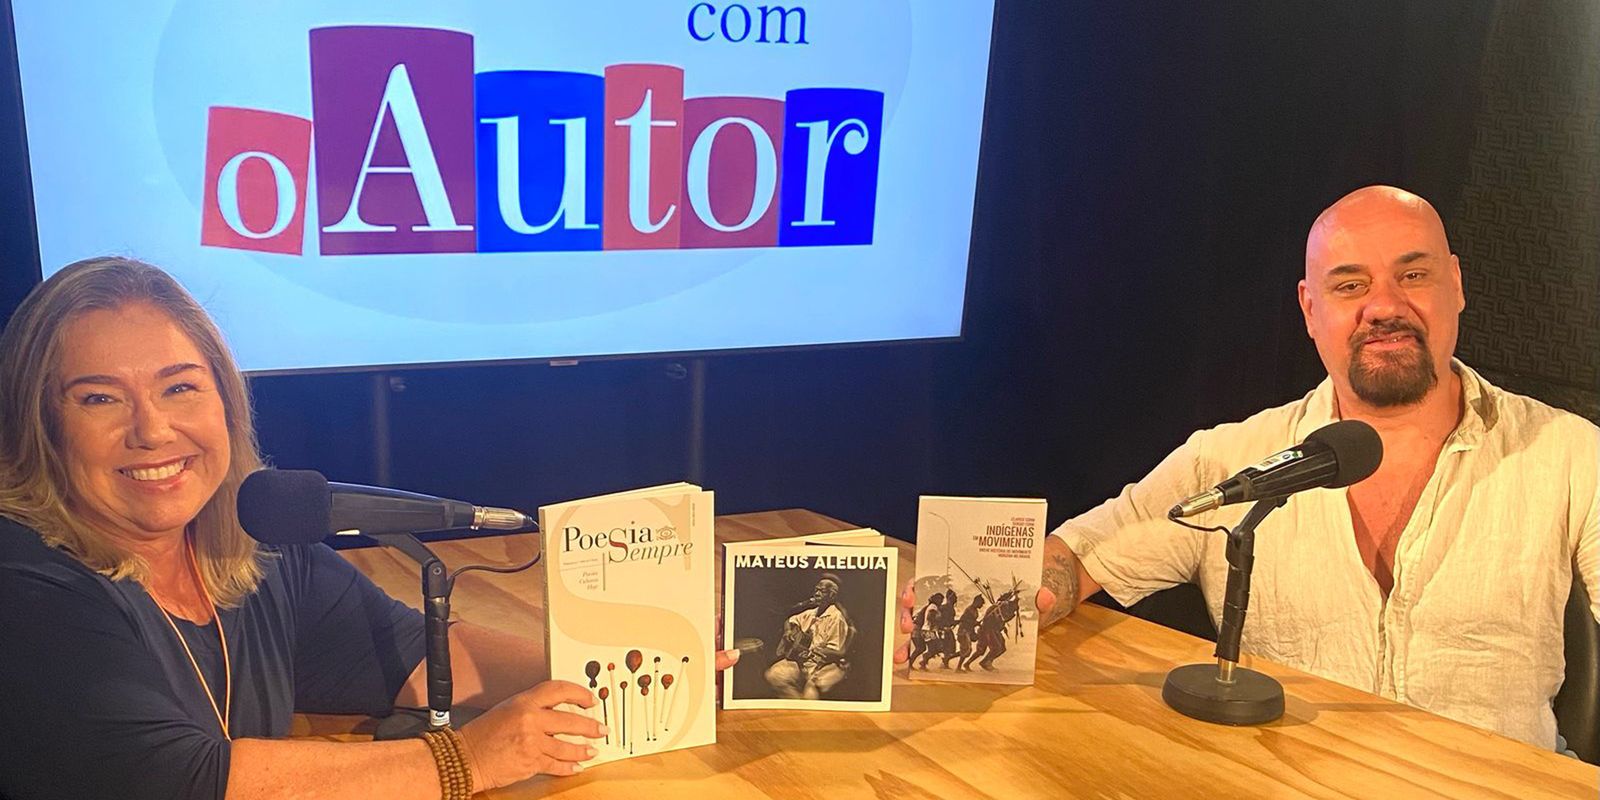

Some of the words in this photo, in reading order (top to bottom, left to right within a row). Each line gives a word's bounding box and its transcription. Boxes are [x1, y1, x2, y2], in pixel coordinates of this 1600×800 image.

[687, 2, 810, 45] com
[986, 523, 1035, 537] INDÍGENAS
[978, 536, 1034, 549] MOVIMENTO
[735, 555, 809, 569] MATEUS
[813, 556, 887, 570] ALELUIA
